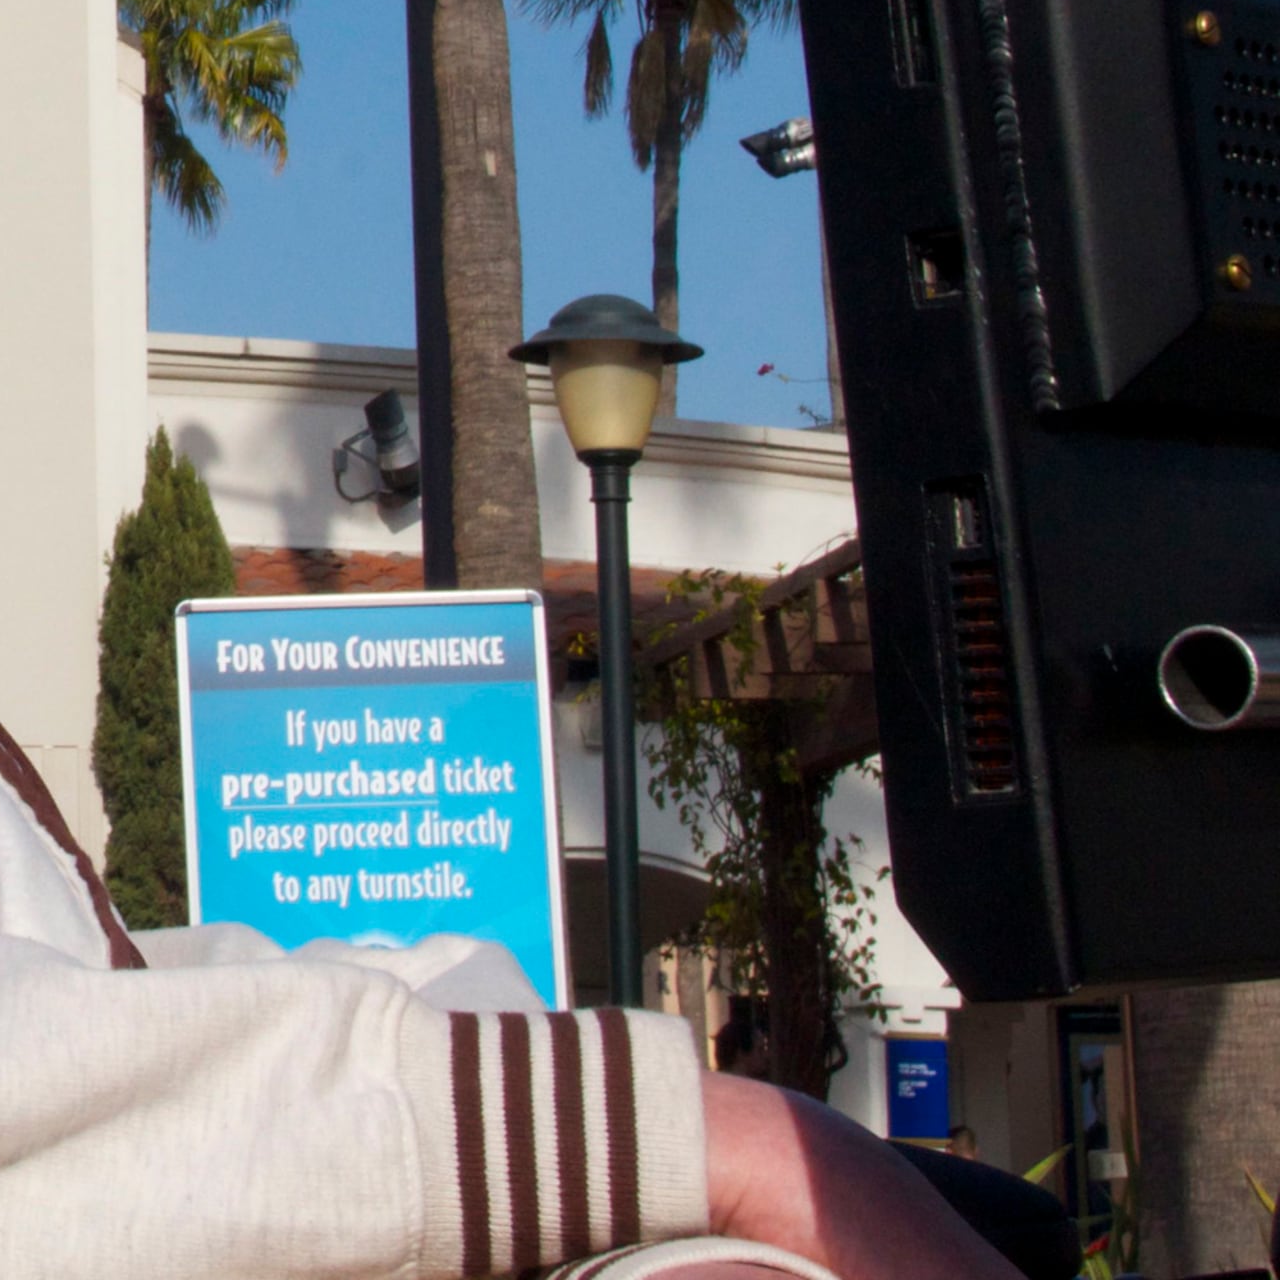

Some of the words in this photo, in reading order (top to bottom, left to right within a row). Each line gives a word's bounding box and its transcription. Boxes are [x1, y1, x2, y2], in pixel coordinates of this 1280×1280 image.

[216, 640, 265, 673] FOR
[271, 638, 339, 671] YOUR
[345, 636, 505, 668] CONVENIENCE
[286, 710, 307, 746] If
[312, 720, 357, 752] you
[365, 708, 421, 744] have
[429, 716, 445, 742] a
[222, 758, 437, 806] pre-purchased
[443, 757, 515, 793] ticket
[229, 816, 306, 859] please
[314, 811, 409, 856] proceed
[417, 808, 512, 852] directly
[273, 871, 301, 903] to
[307, 873, 351, 909] any
[358, 862, 474, 898] turnstile.
